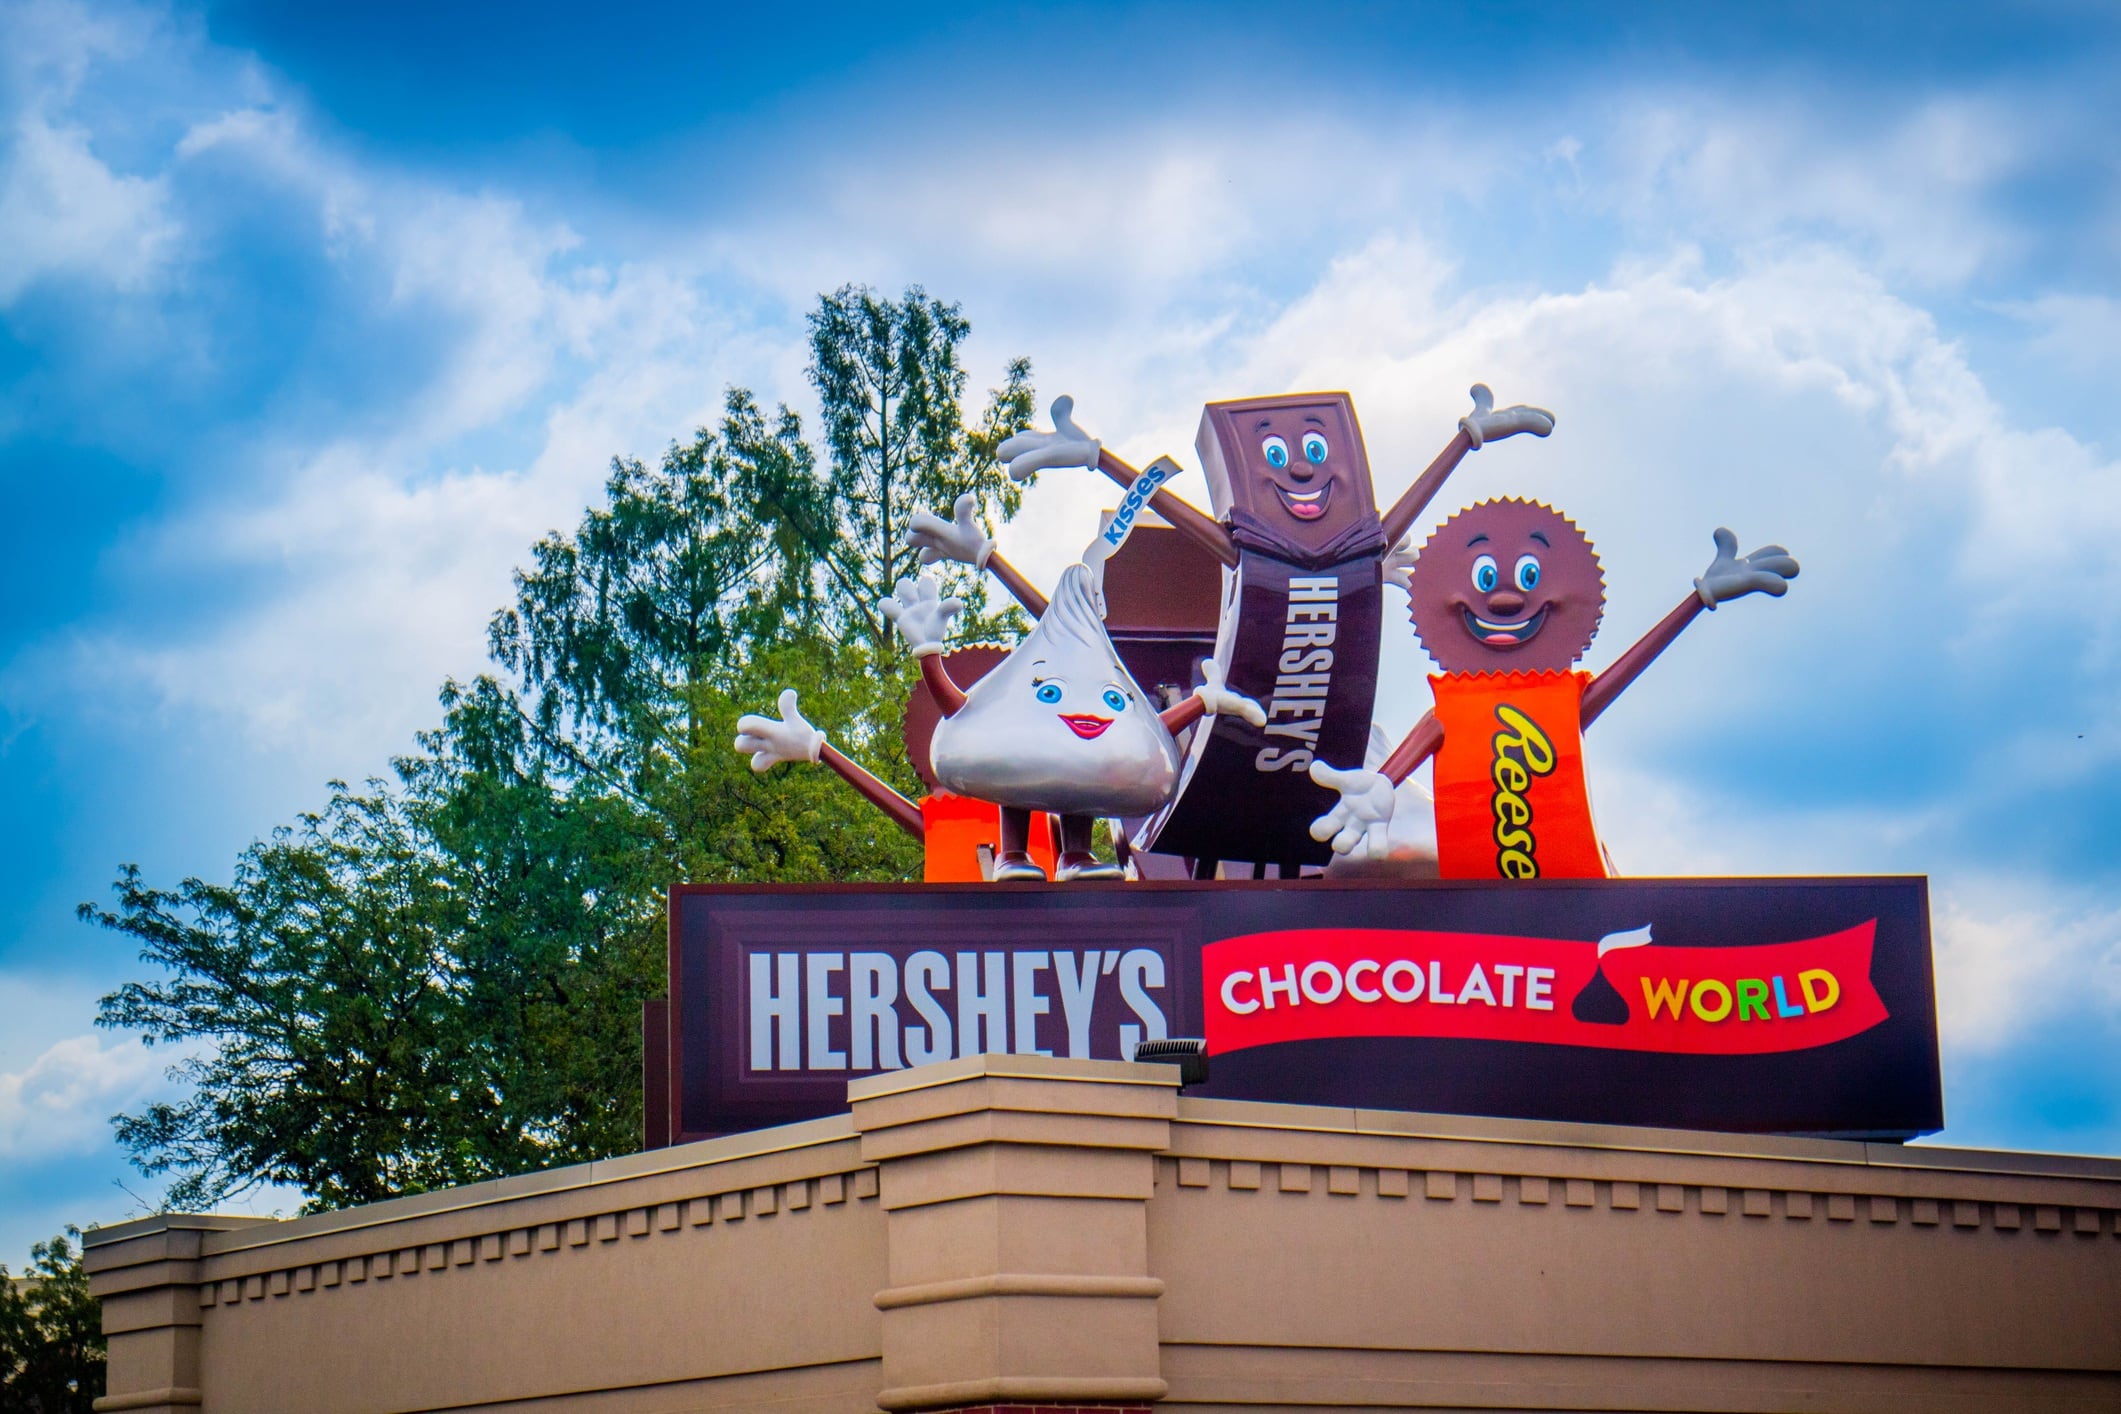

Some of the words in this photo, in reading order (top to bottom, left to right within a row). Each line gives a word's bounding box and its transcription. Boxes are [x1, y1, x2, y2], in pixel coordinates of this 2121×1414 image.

[1255, 577, 1338, 772] HERSHEY'S
[1493, 705, 1555, 879] Reese
[749, 948, 1168, 1071] HERSHEY'S
[1221, 959, 1555, 1014] CHOCOLATE
[1640, 968, 1841, 1022] WORLD
